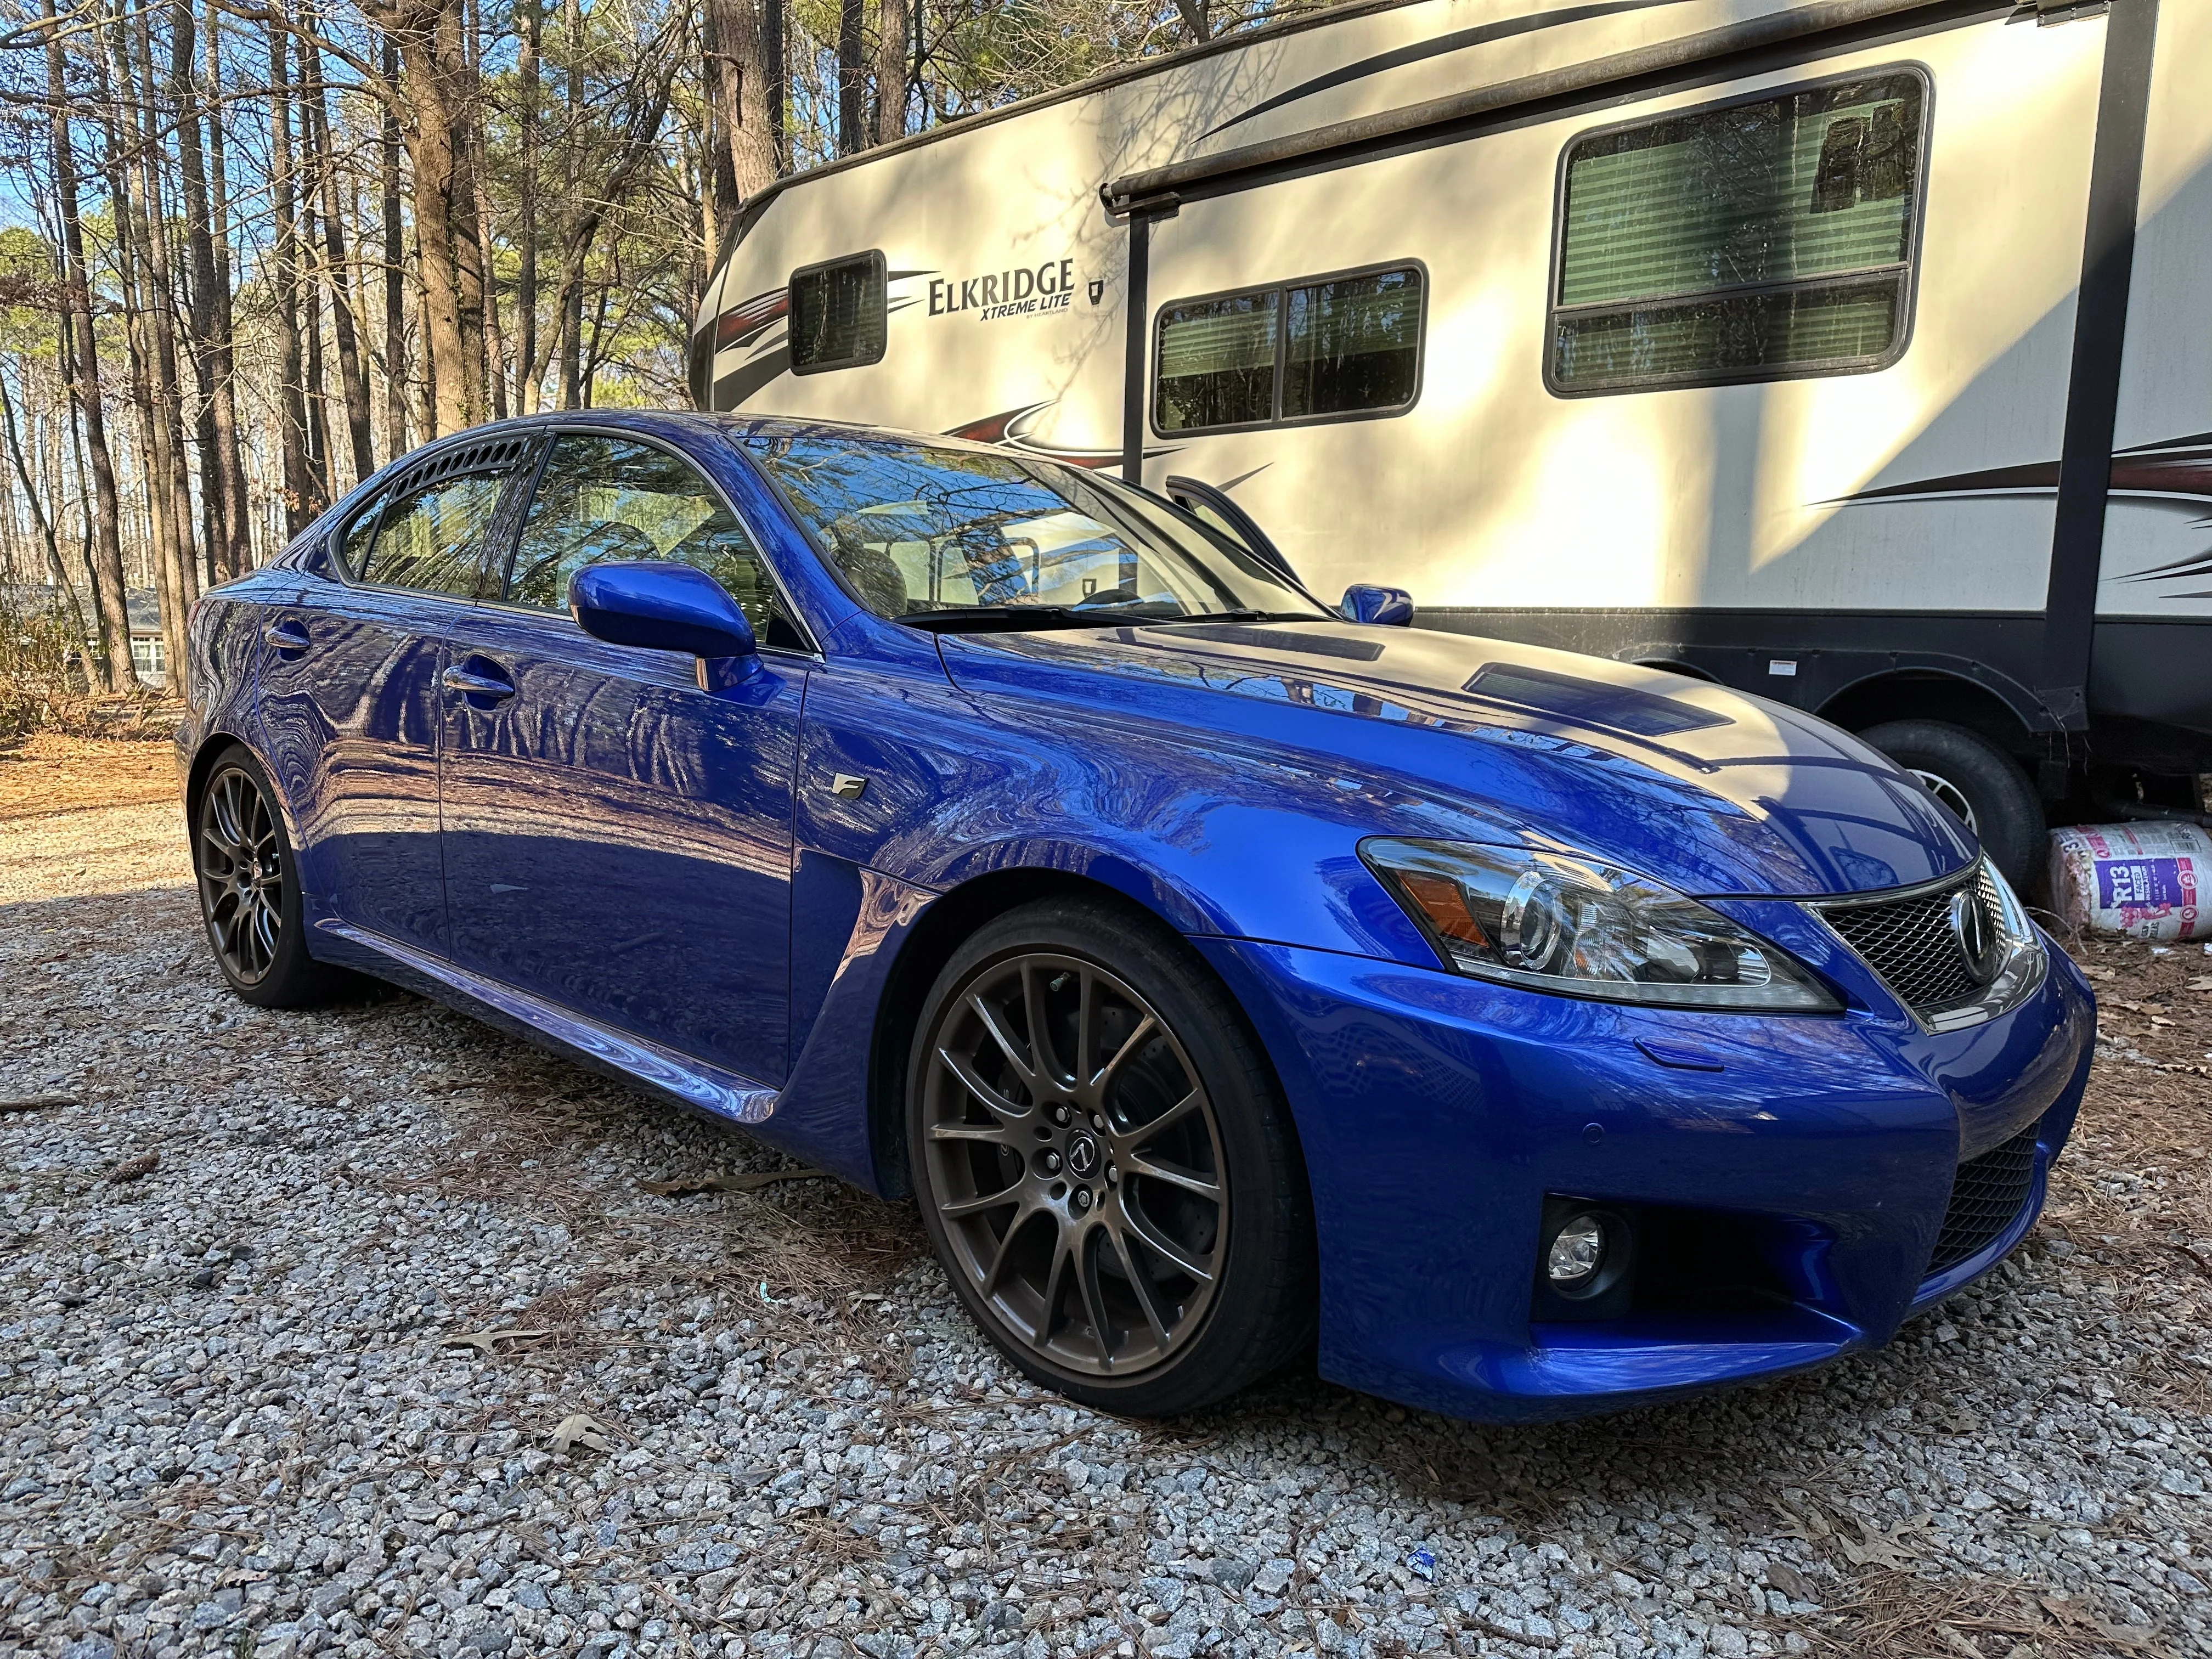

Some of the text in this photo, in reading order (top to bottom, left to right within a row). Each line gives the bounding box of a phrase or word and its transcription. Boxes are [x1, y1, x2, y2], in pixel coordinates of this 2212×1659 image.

[928, 258, 1075, 317] ELKRIDGE
[980, 292, 1072, 321] XTREME LITE
[1034, 308, 1068, 317] HEARTLAND
[831, 772, 865, 794] F
[2109, 866, 2132, 901] R13
[2134, 872, 2142, 894] FACED
